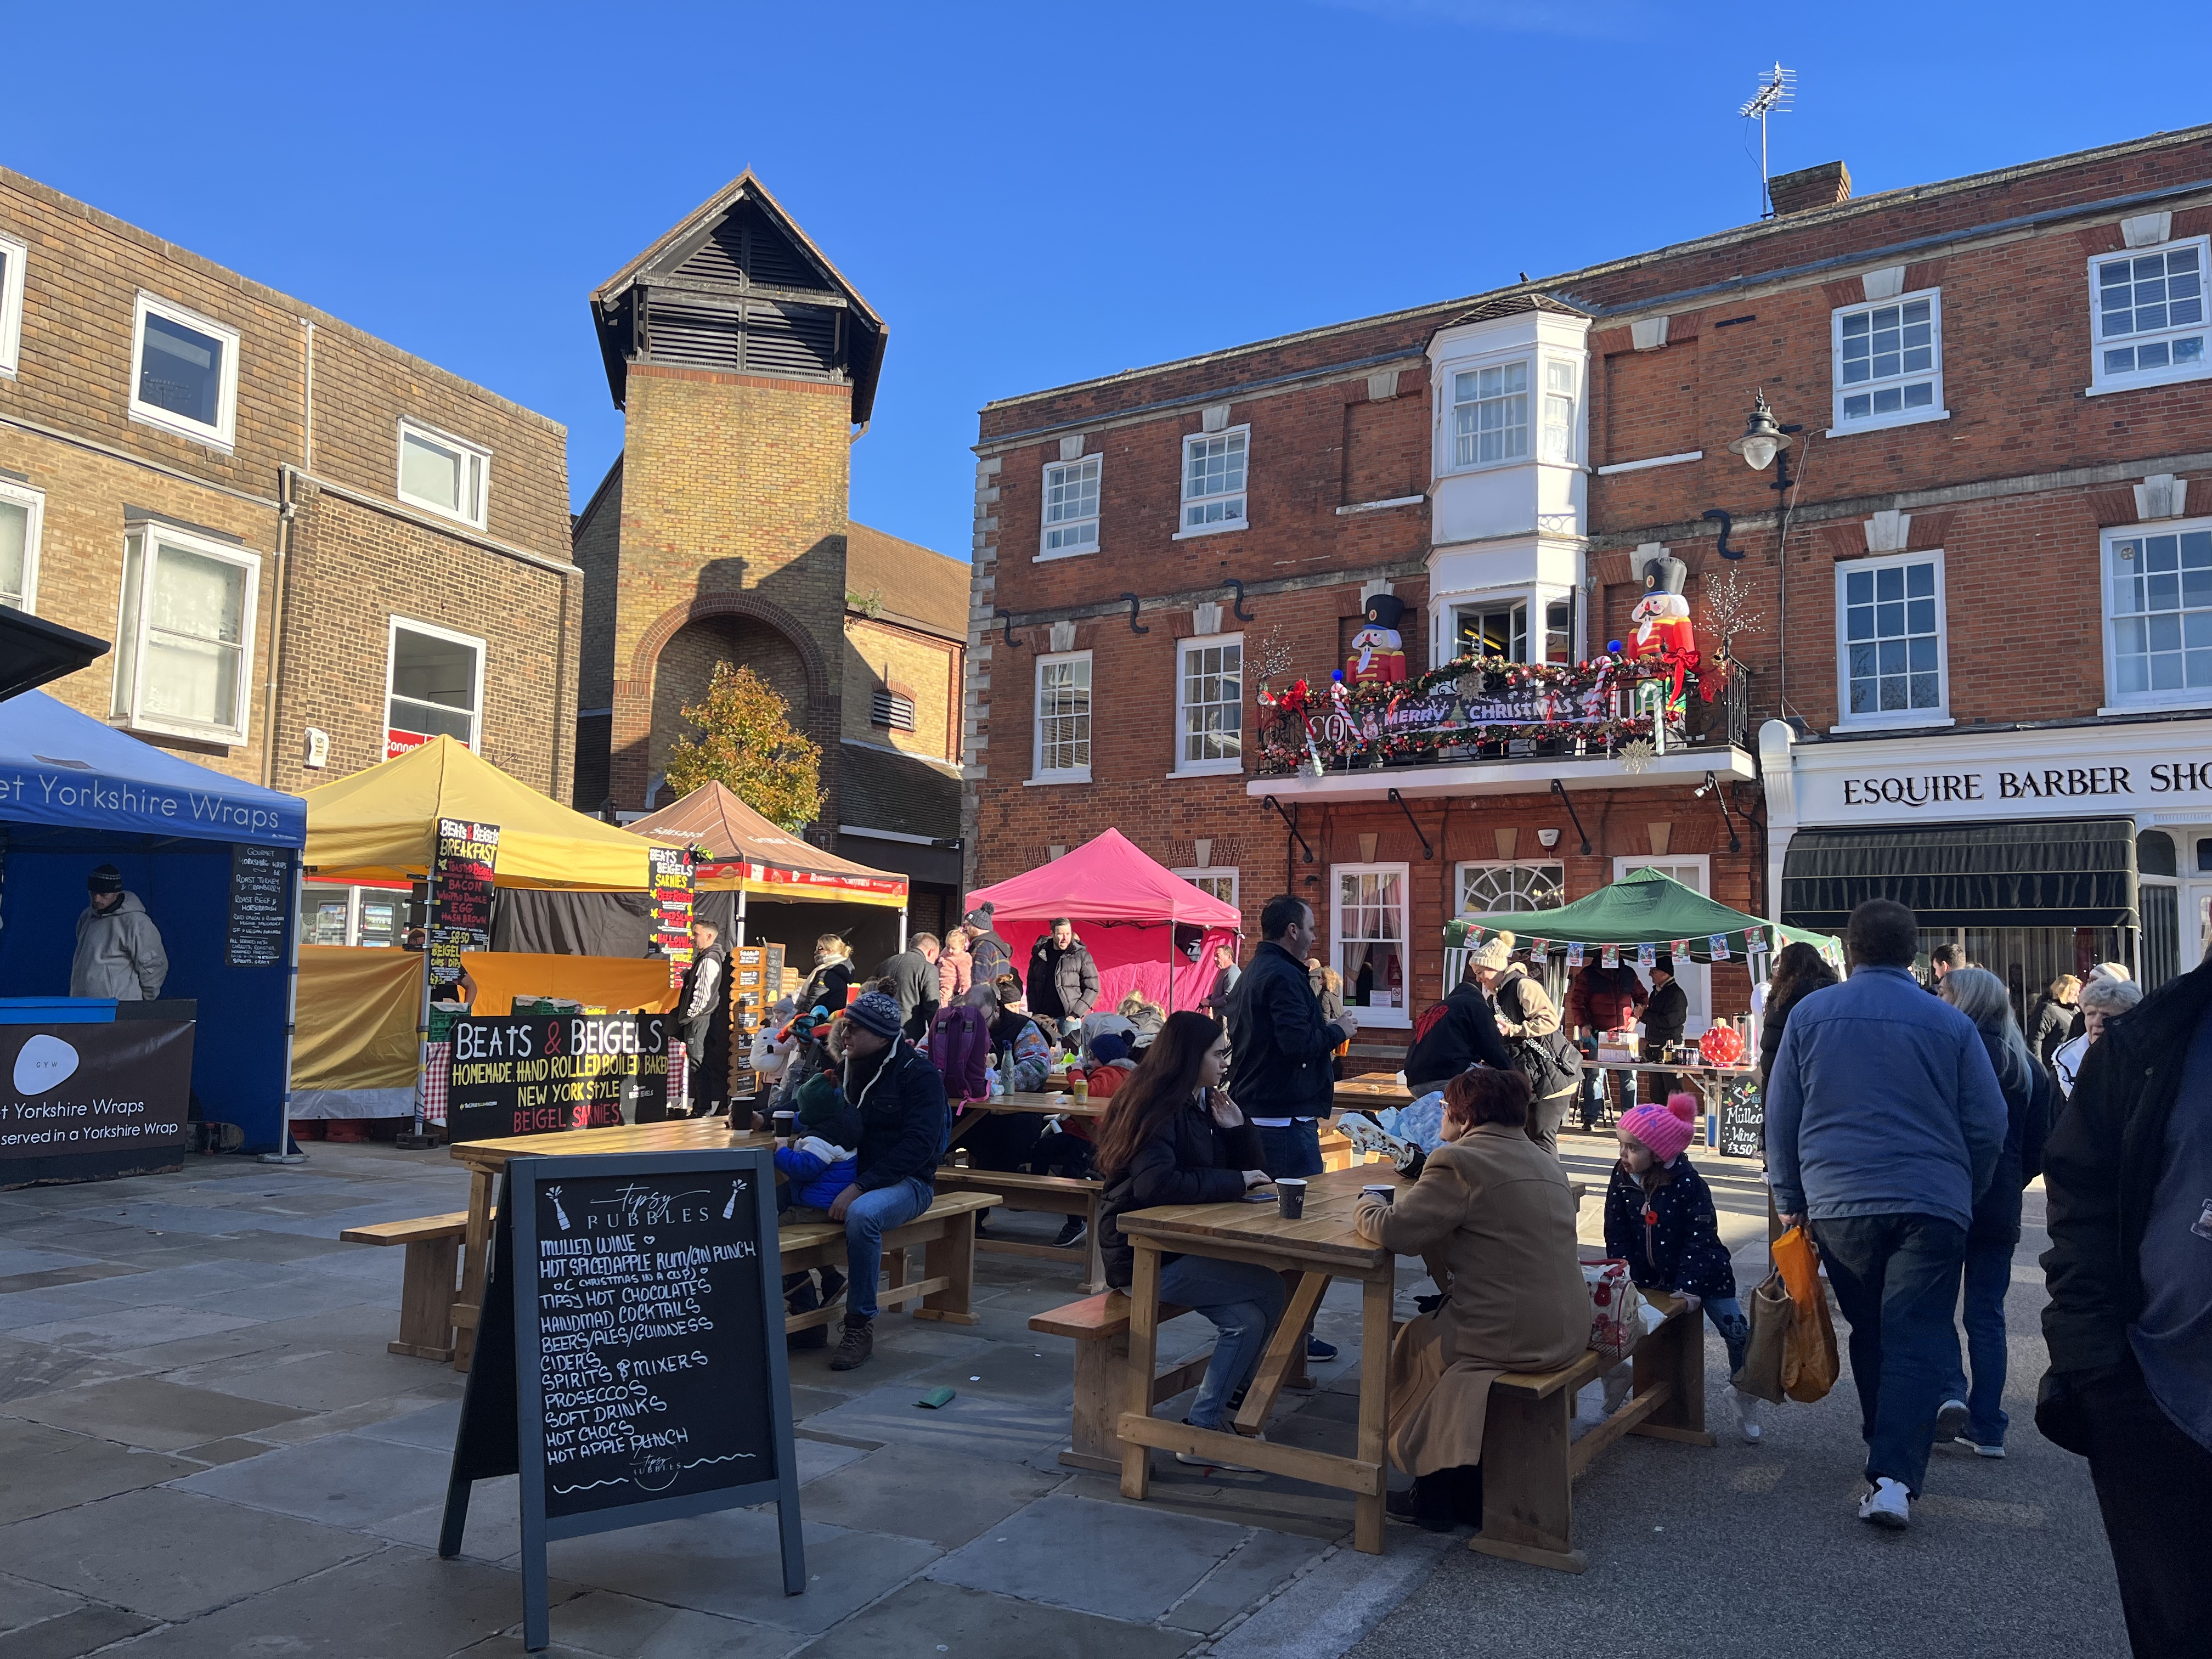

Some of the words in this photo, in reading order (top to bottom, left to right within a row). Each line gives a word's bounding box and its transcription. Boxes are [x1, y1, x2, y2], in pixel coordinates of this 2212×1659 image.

[1384, 708, 1446, 727] MERRY
[1469, 697, 1573, 721] CHRISTMAS
[1844, 773, 1984, 808] ESQUIRE
[1999, 766, 2135, 800] BARBER
[39, 774, 178, 817] Yorkshire
[189, 792, 279, 833] Wraps
[467, 825, 472, 840] &
[247, 848, 275, 857] GOURMET
[682, 852, 691, 865] &
[236, 874, 256, 884] ROAST
[257, 876, 279, 885] TURKEY
[248, 884, 280, 893] CRANBERRY
[448, 879, 482, 892] BACON
[235, 895, 253, 903] ROAST
[451, 902, 473, 913] EGG
[462, 914, 487, 925] BROWN
[544, 1021, 562, 1055] &
[516, 1058, 549, 1082] HAND
[517, 1085, 548, 1108] NEW
[552, 1081, 585, 1103] YORK
[14, 1102, 87, 1119] Yorkshire
[93, 1098, 144, 1117] Wraps
[1, 1129, 51, 1146] served
[54, 1128, 65, 1142] in
[69, 1130, 79, 1141] a
[83, 1124, 140, 1140] Yorkshire
[144, 1122, 178, 1136] Wrap
[1732, 1126, 1756, 1142] Wine
[540, 1238, 592, 1257] MULLED
[596, 1233, 636, 1254] WINE
[540, 1259, 568, 1278] HOT
[713, 1240, 757, 1262] PUNCH
[642, 1272, 653, 1282] IN
[656, 1272, 664, 1281] A
[539, 1294, 583, 1310] TIPSY
[586, 1289, 616, 1307] HOT
[622, 1278, 712, 1303] CHOCOLATES
[618, 1297, 701, 1325] COCKTAILS
[540, 1352, 602, 1372] CIDERS
[541, 1366, 613, 1391] SPIRITS
[633, 1350, 708, 1378] MIXERS
[544, 1379, 648, 1410] PROSECCOS
[545, 1409, 590, 1428] SOFT
[593, 1395, 668, 1423] DRINKS
[546, 1429, 575, 1447] HOT
[578, 1420, 635, 1442] CHOCS
[548, 1447, 577, 1465] HOT
[580, 1436, 625, 1459] APPLE
[629, 1427, 689, 1451] PUNCH
